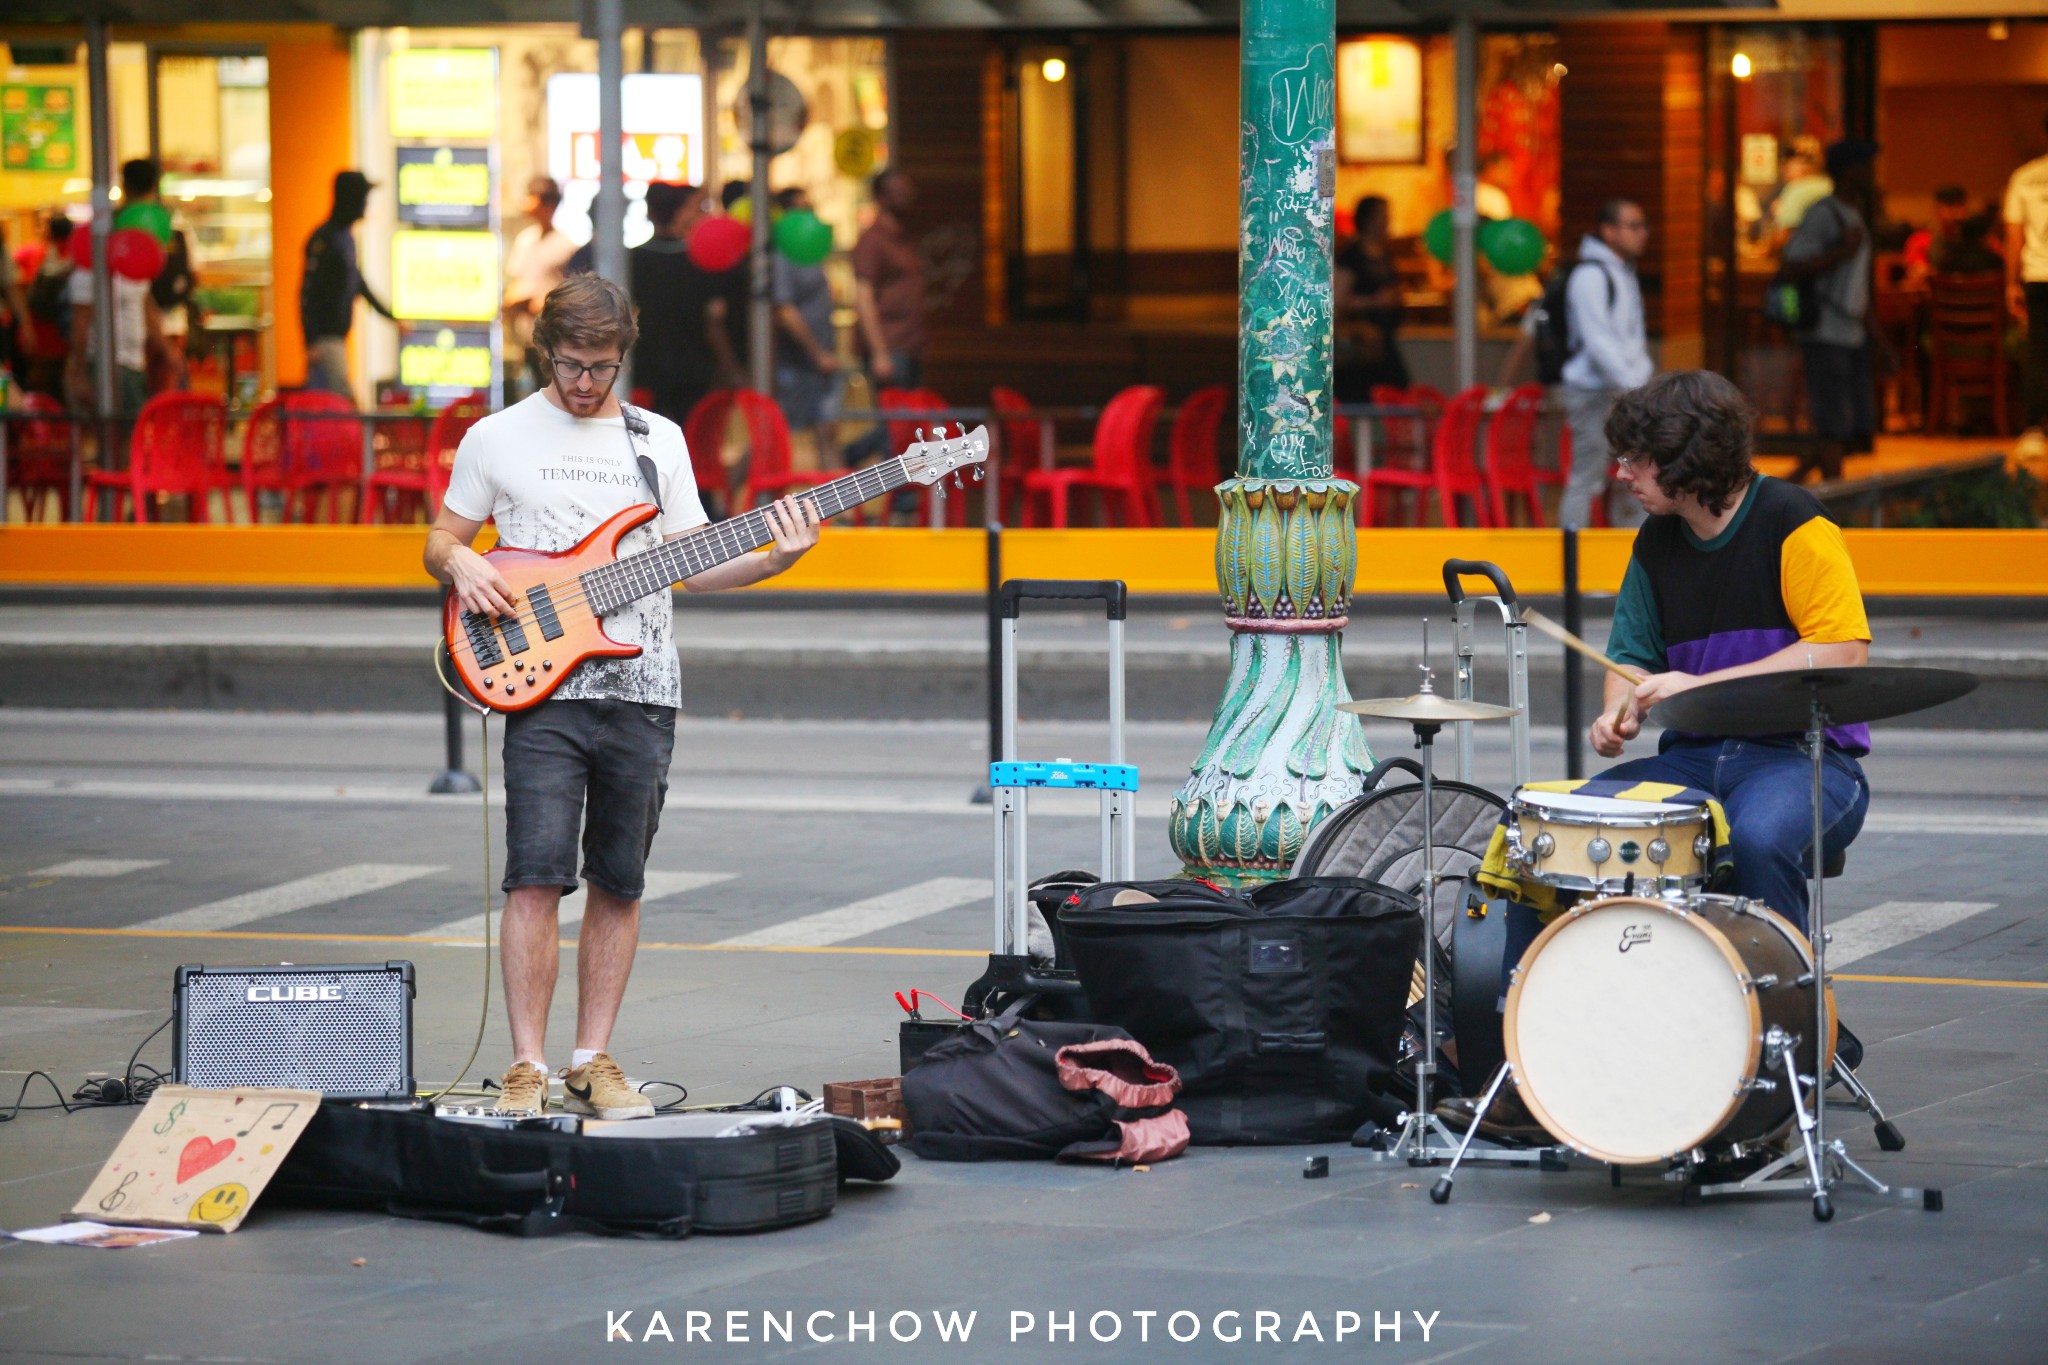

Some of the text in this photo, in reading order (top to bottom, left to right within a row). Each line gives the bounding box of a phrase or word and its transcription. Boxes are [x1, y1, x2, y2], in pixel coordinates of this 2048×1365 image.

[561, 455, 623, 467] THIS IS ONLY
[539, 468, 642, 488] TEMPORARY
[247, 986, 342, 1001] CUBE
